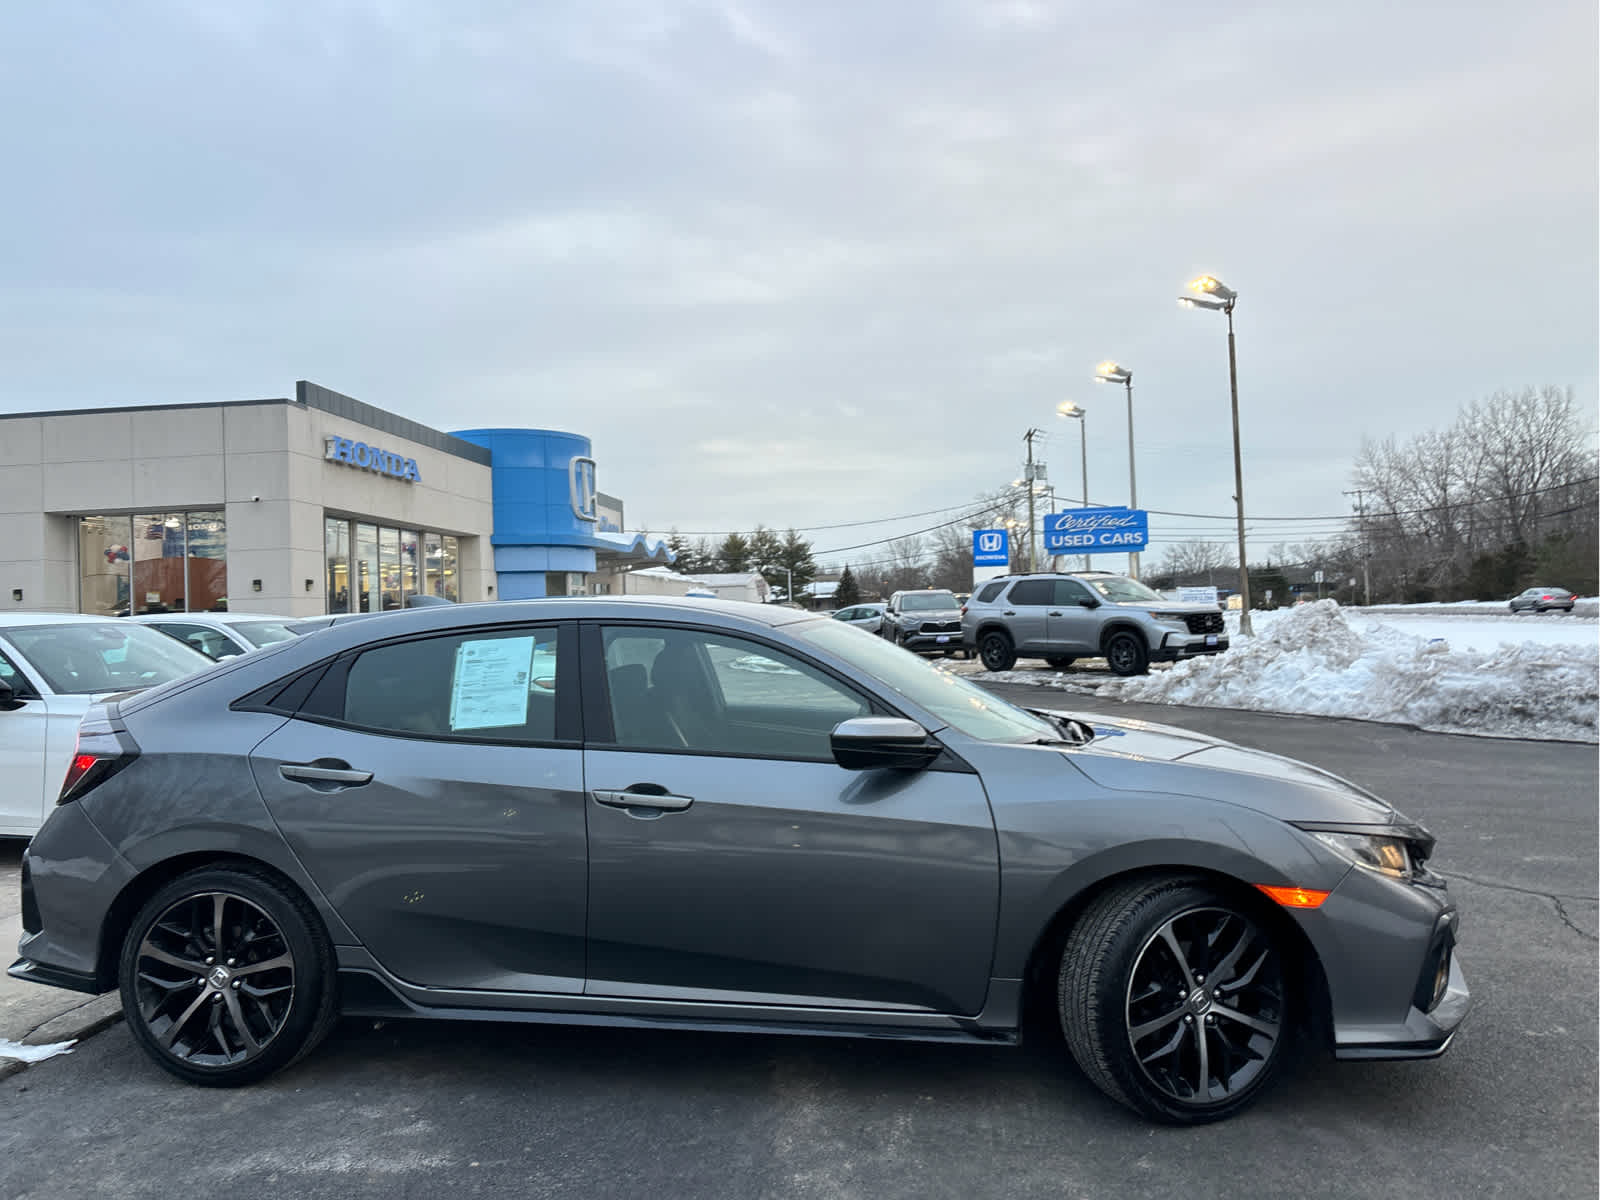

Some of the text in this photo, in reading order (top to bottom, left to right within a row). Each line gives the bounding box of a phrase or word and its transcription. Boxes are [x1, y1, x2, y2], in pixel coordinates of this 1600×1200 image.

[330, 435, 422, 482] HONDA
[1056, 514, 1138, 533] Certified
[1051, 532, 1143, 546] USED CARS
